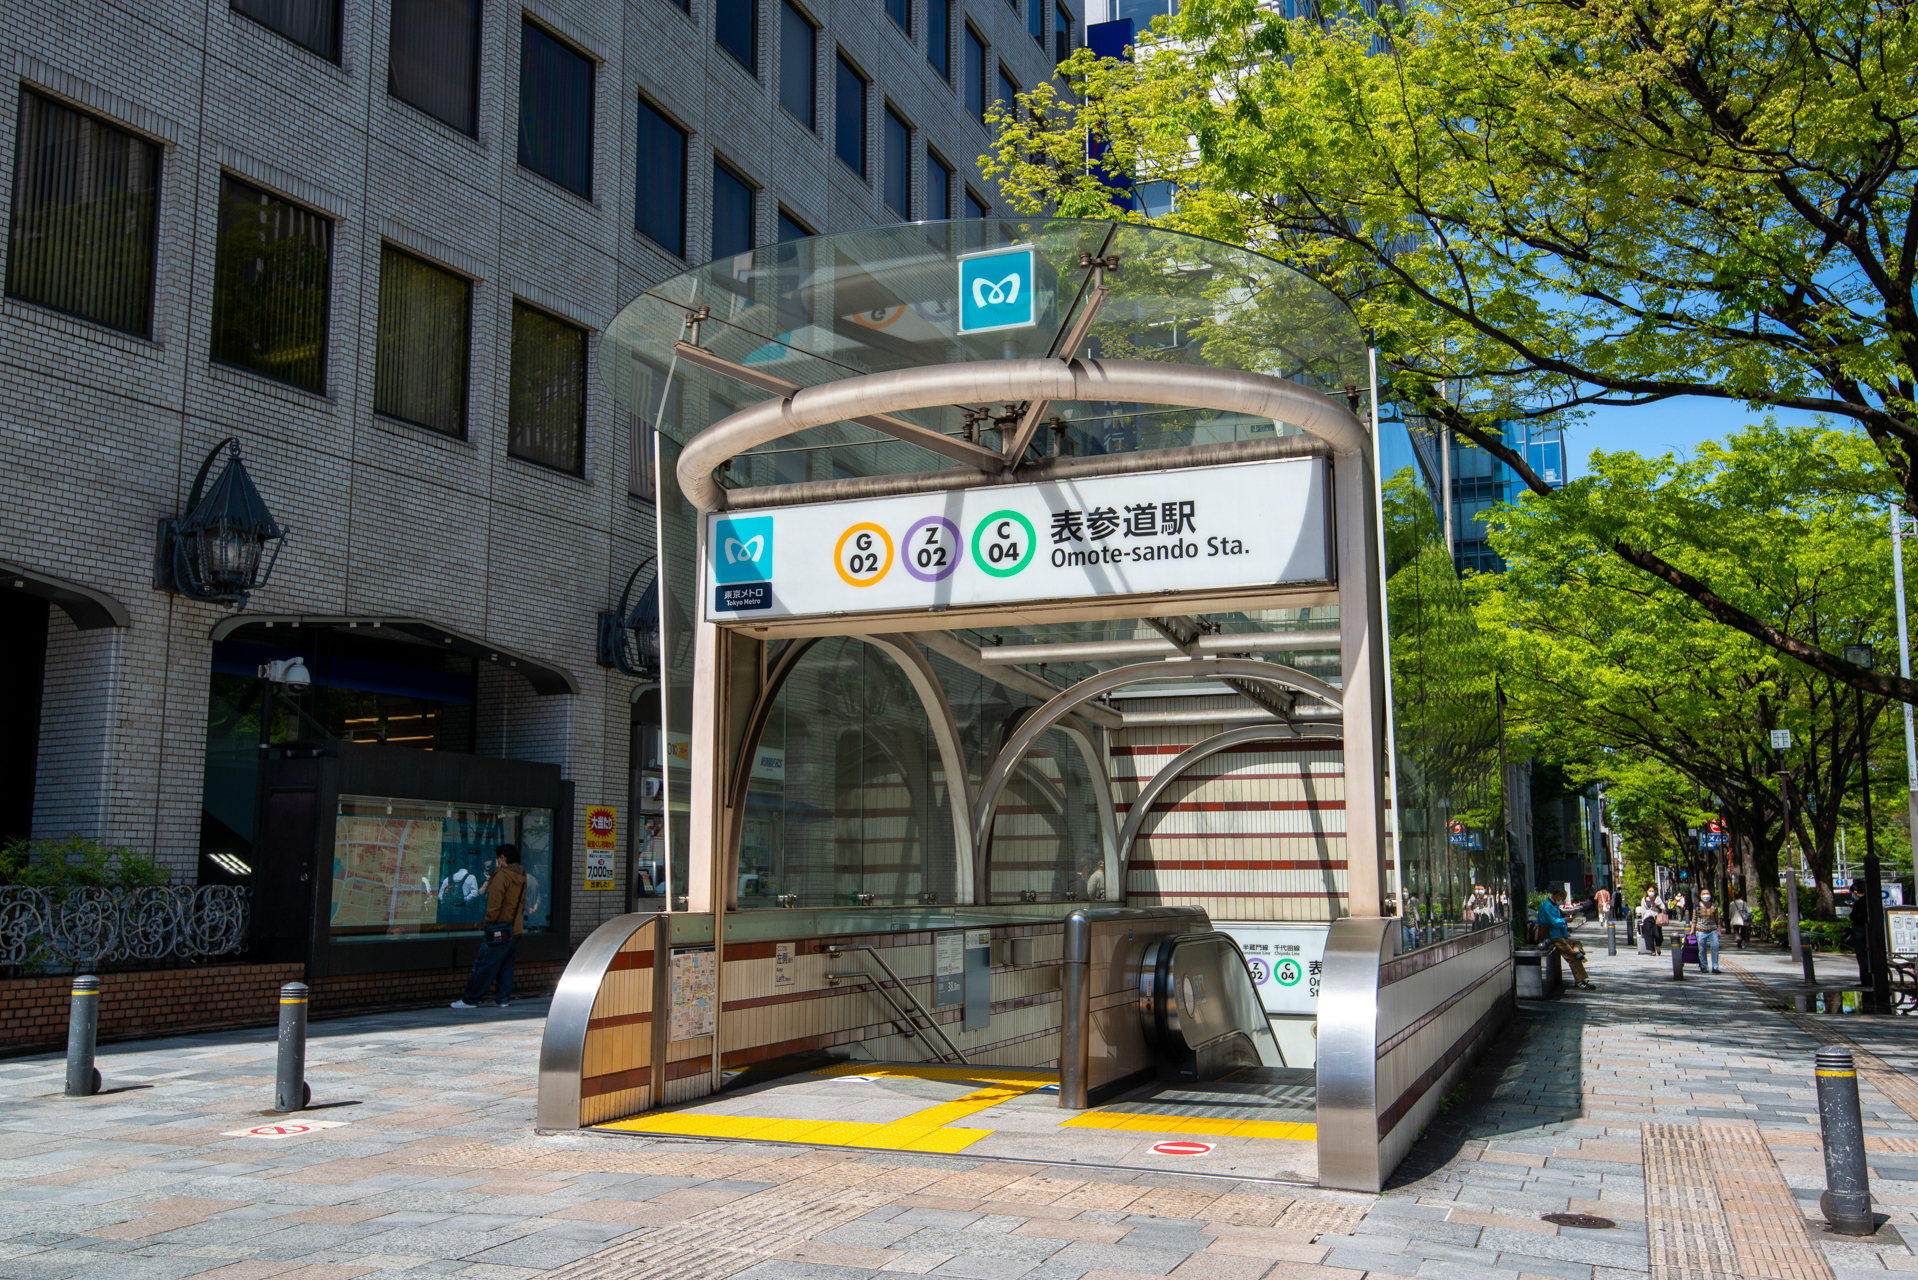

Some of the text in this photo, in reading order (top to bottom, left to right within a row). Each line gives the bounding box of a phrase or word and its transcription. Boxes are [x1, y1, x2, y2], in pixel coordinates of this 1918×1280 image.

[997, 521, 1010, 540] C
[1050, 500, 1197, 544] 表参道駅
[856, 533, 872, 551] G
[925, 527, 939, 545] Z
[917, 547, 947, 567] 02
[989, 542, 1019, 563] 04
[1051, 534, 1250, 568] Omote-sando Sta.
[850, 553, 878, 573] 02
[724, 588, 763, 600] 東京メトロ
[591, 816, 612, 830] 大当たり
[1243, 944, 1269, 952] 半蔵門線
[1281, 972, 1295, 980] 04
[1284, 963, 1291, 971] C
